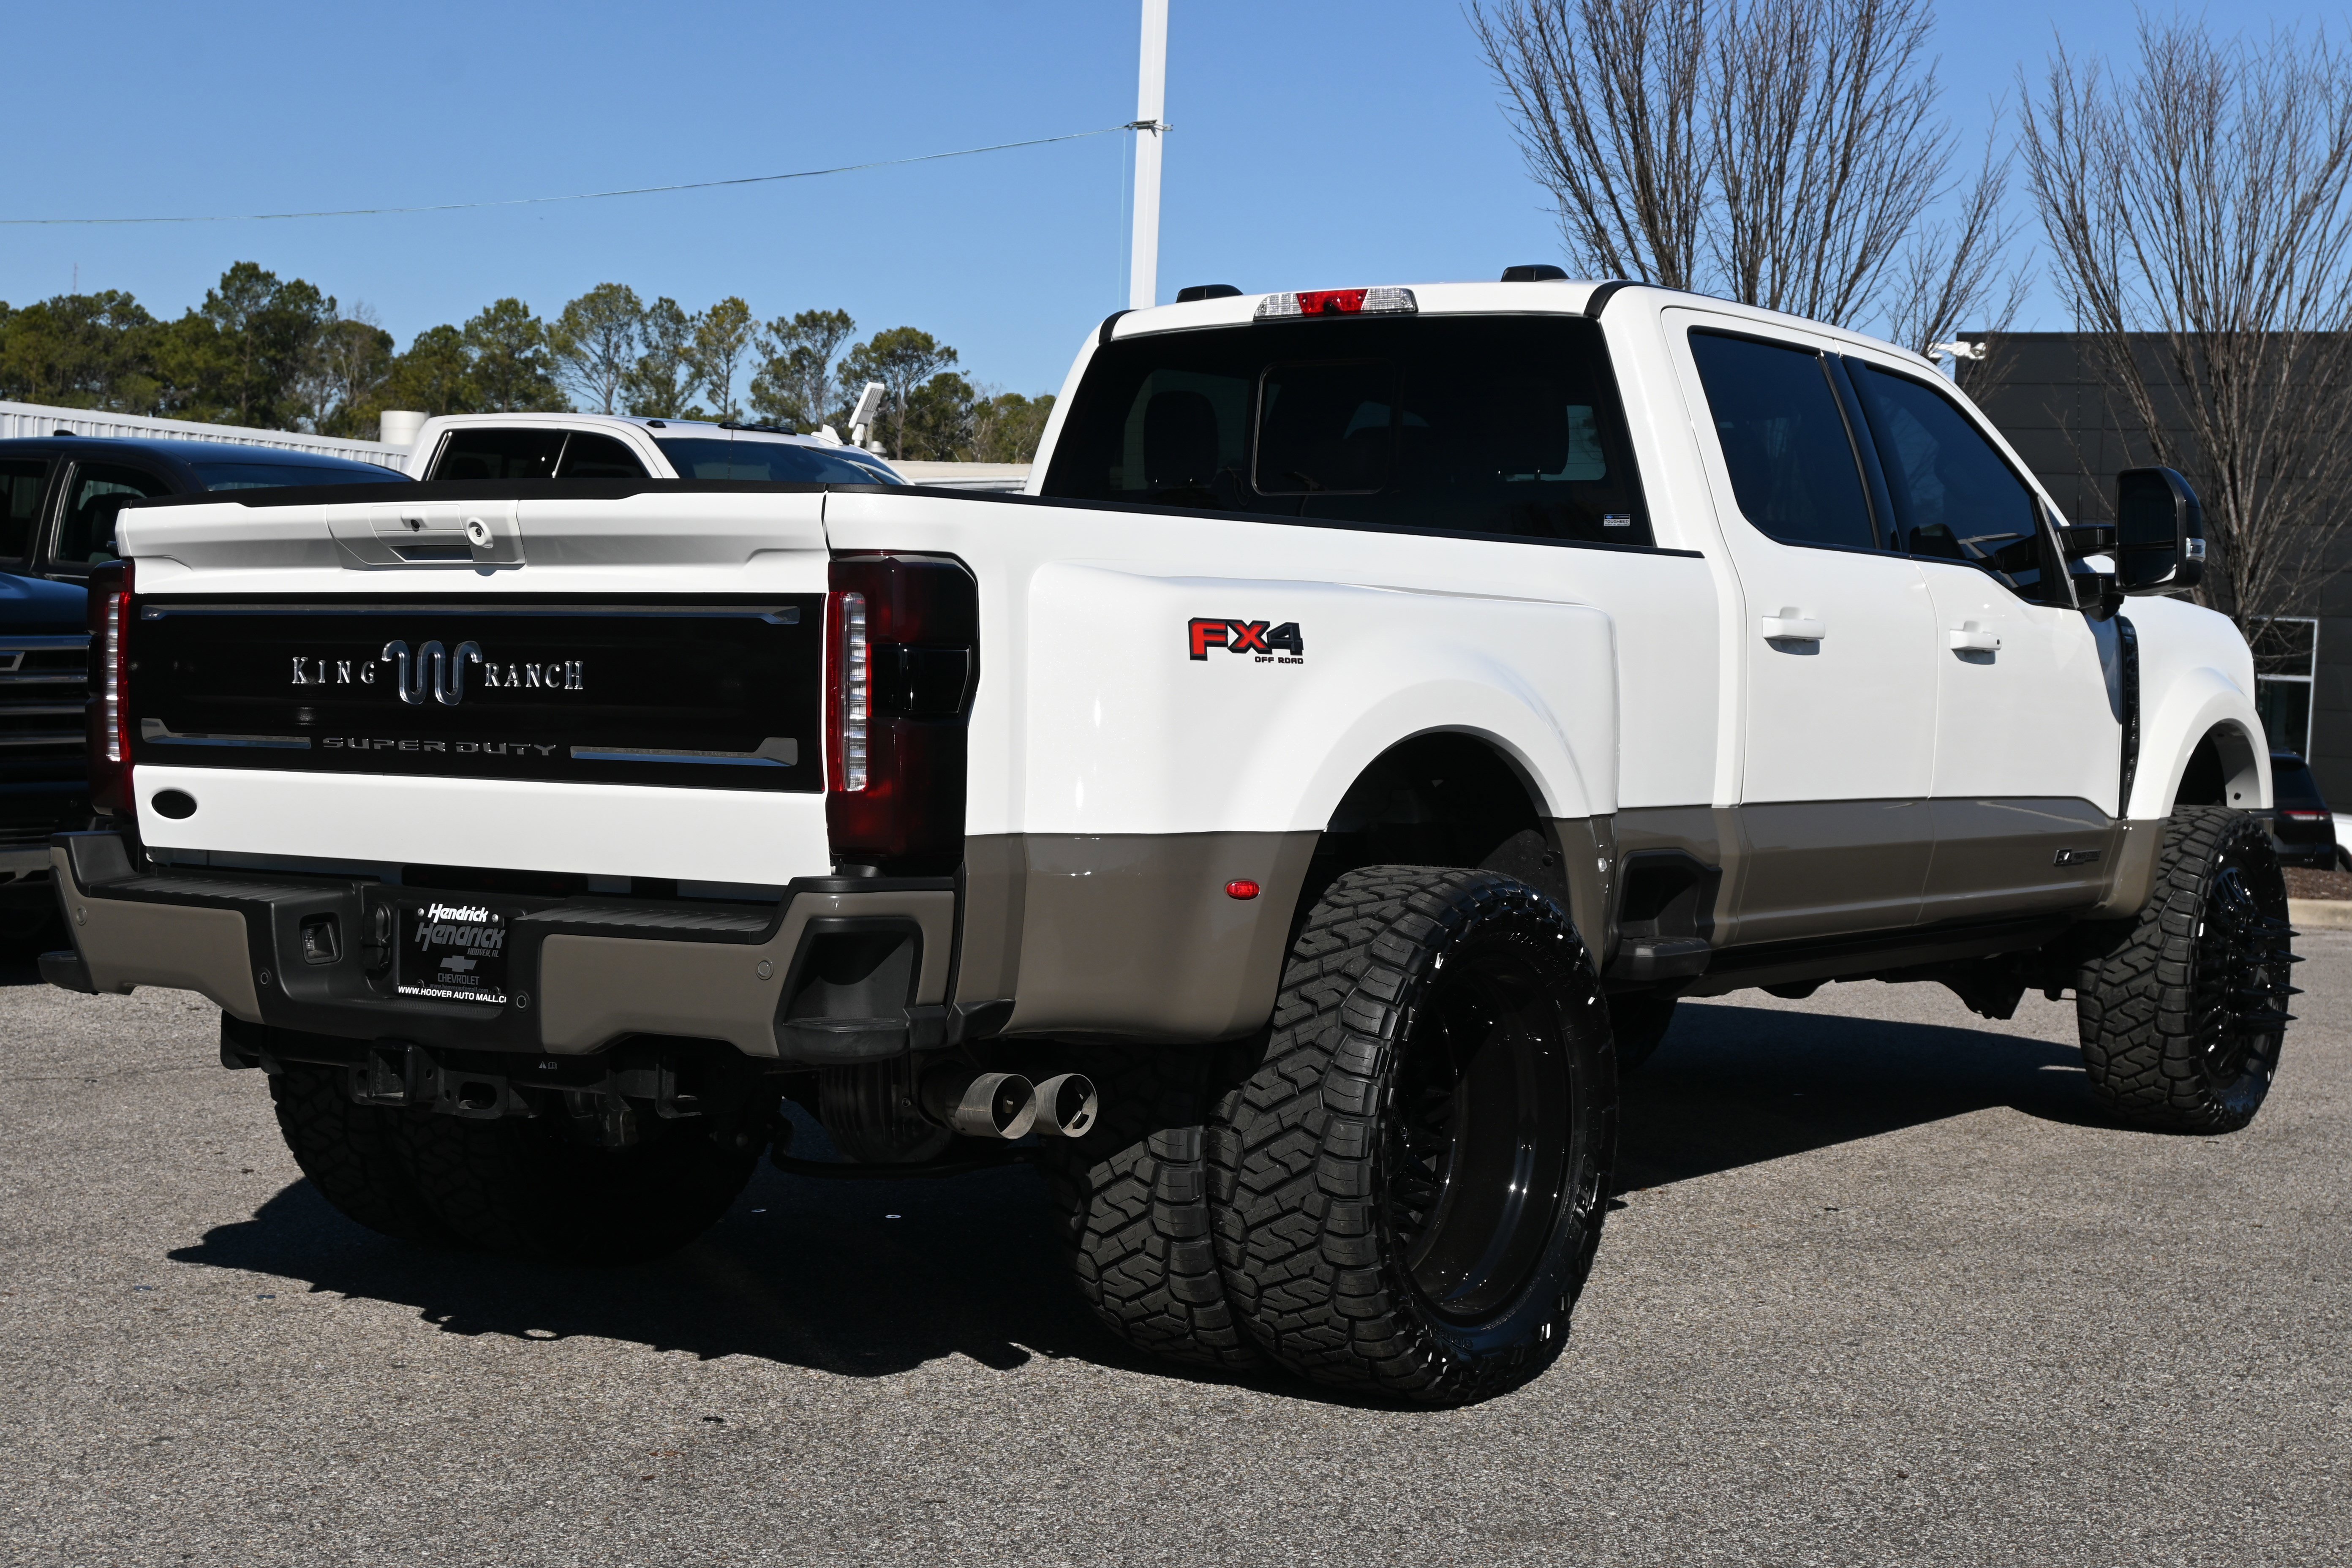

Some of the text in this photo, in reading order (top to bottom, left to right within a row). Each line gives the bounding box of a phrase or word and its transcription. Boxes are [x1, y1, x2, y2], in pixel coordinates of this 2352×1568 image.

[1188, 617, 1304, 661] FX4
[292, 656, 584, 690] KING RANCH
[322, 737, 557, 757] SUPER DUTY
[427, 903, 489, 923] Hendrick
[415, 922, 506, 951] Hendrick
[467, 948, 499, 958] HOOVER, AL
[437, 972, 480, 986] CHEVROLET
[398, 986, 452, 998] WWW.HOOVER
[453, 991, 475, 1000] AUTO
